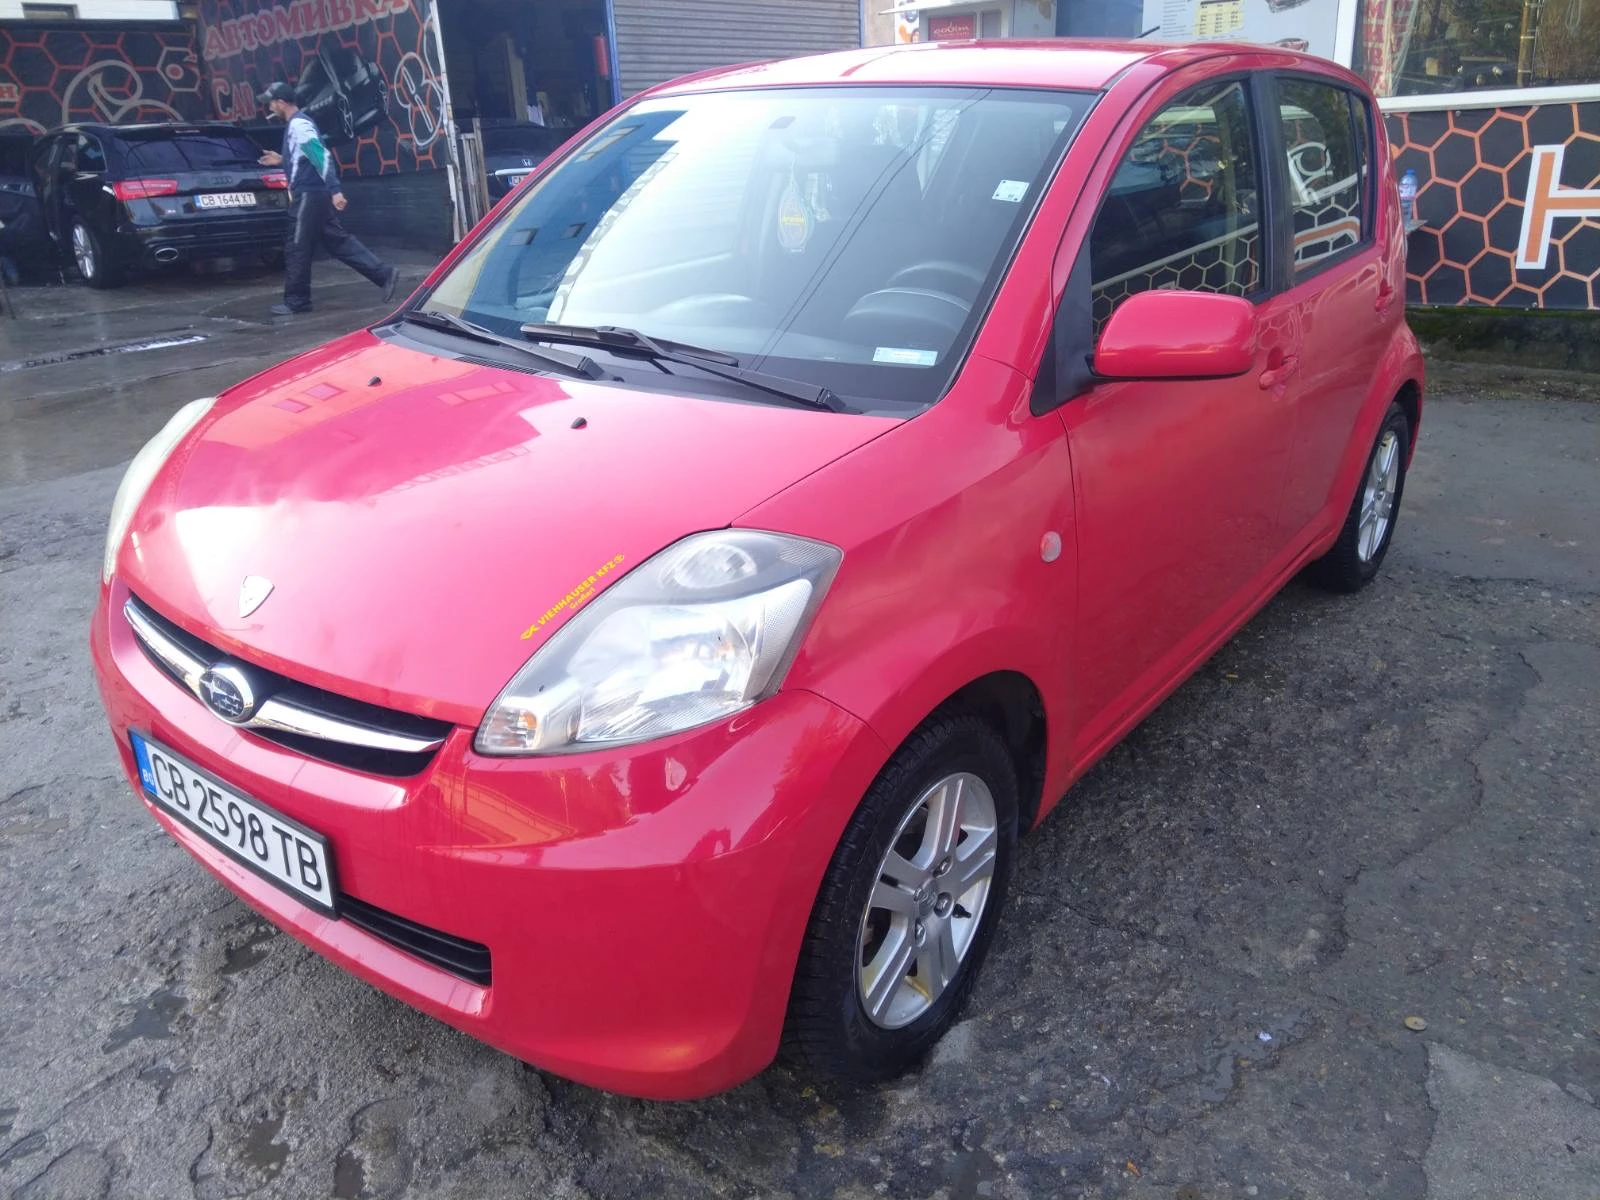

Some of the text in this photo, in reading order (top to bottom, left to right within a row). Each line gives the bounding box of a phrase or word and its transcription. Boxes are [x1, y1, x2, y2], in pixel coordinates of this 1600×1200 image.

[201, 194, 253, 206] CB 1644 XT
[142, 768, 155, 786] BG
[152, 753, 322, 892] CB 2598 TB
